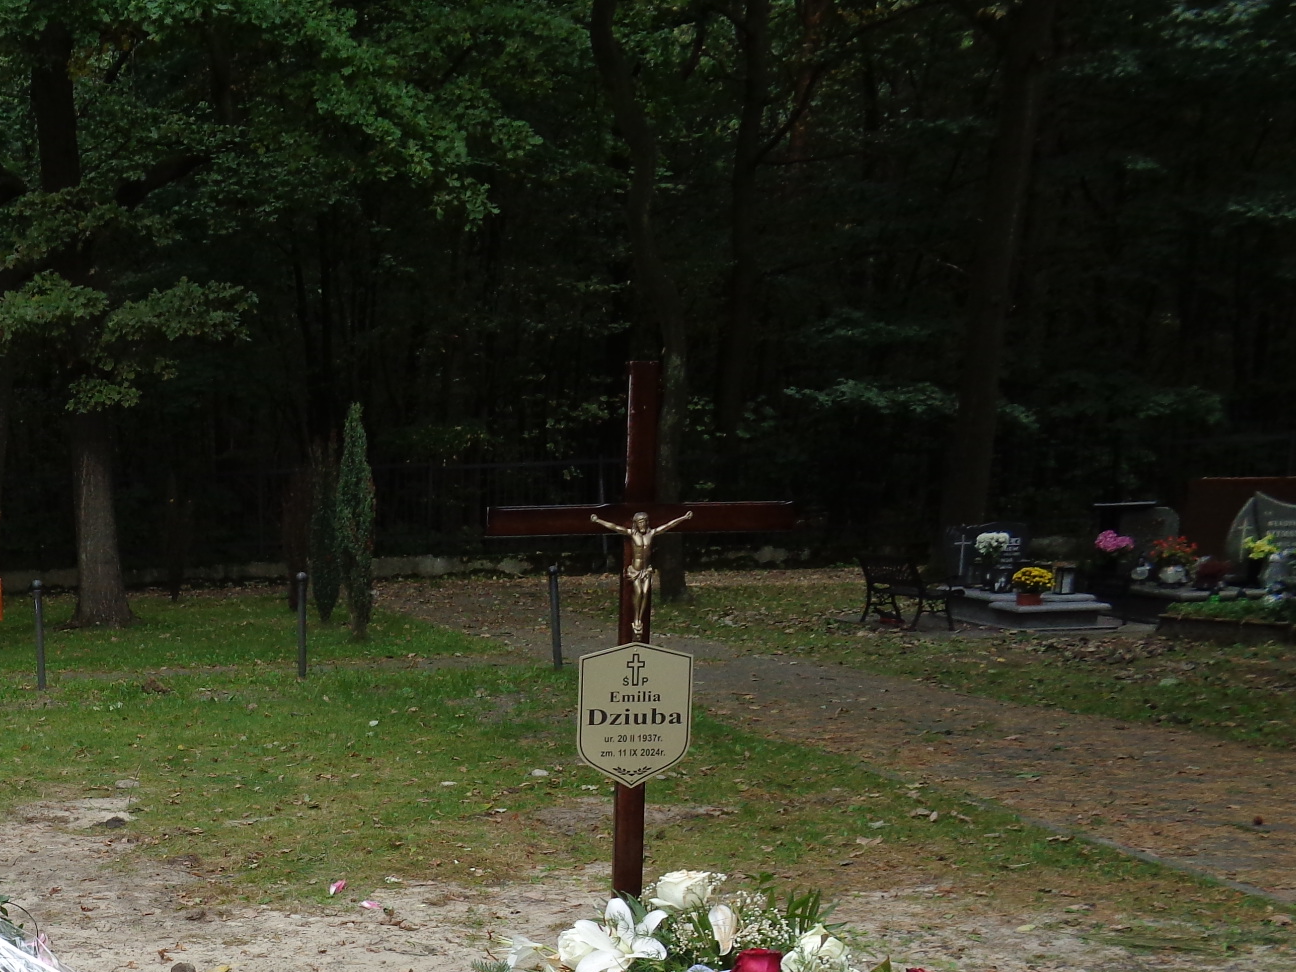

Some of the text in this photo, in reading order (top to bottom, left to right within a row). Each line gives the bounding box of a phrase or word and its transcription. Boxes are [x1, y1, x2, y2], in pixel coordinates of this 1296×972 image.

[609, 690, 661, 703] Emilia
[586, 707, 683, 726] Dziuba
[604, 735, 615, 743] ur.
[617, 734, 628, 743] 20
[637, 734, 663, 742] 1937r.
[618, 749, 627, 757] 11
[629, 748, 638, 757] IX
[640, 748, 666, 757] 2024r.
